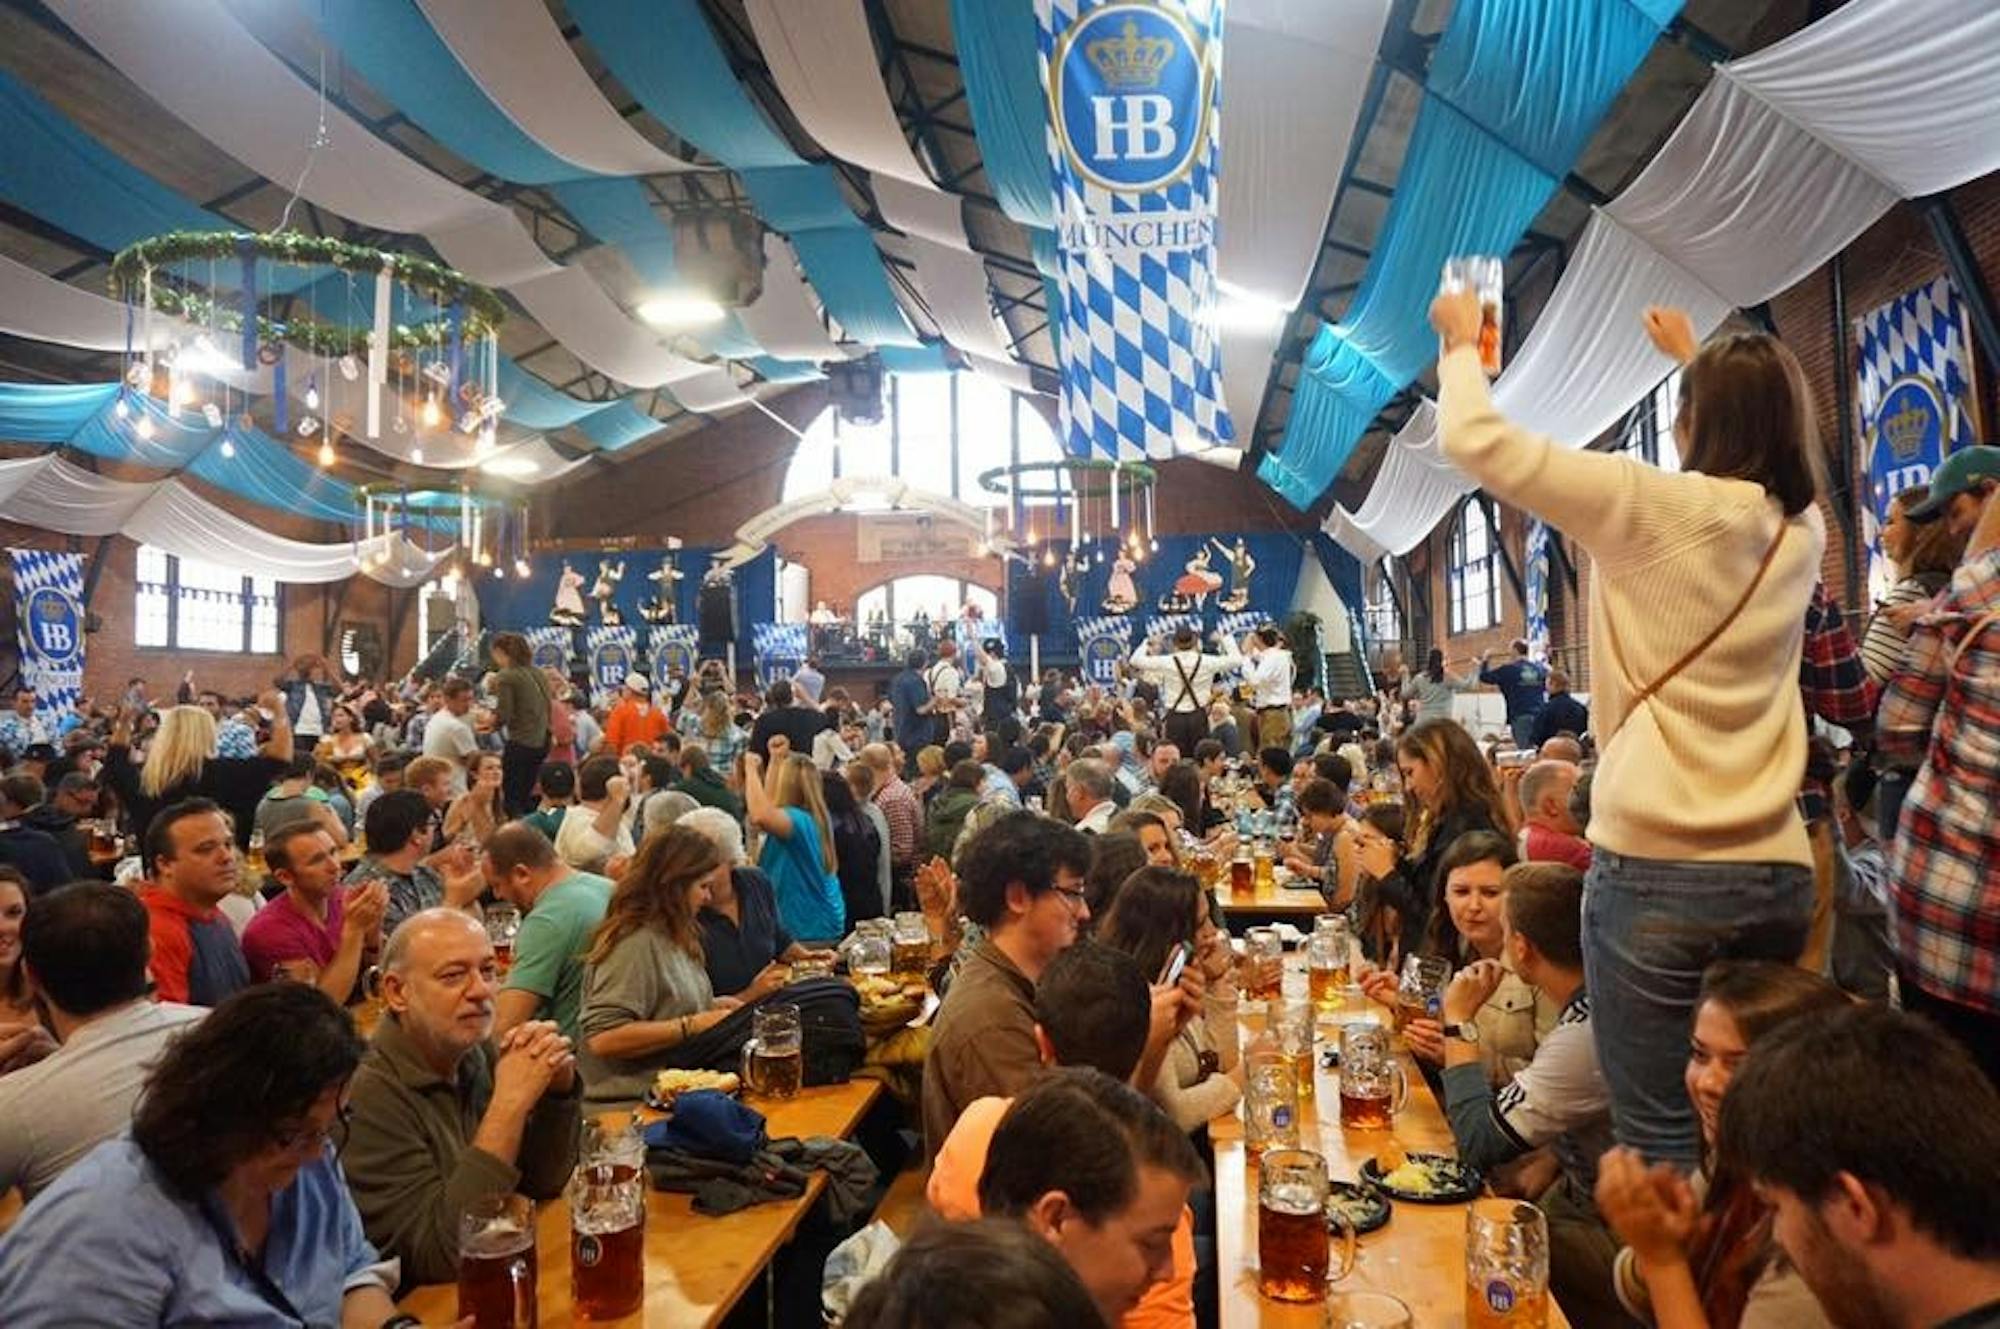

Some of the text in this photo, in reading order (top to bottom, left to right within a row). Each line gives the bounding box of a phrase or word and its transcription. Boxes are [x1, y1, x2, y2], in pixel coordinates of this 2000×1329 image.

[1090, 93, 1176, 161] HB
[1064, 217, 1213, 249] MÜNCHEN
[40, 621, 72, 651] HB
